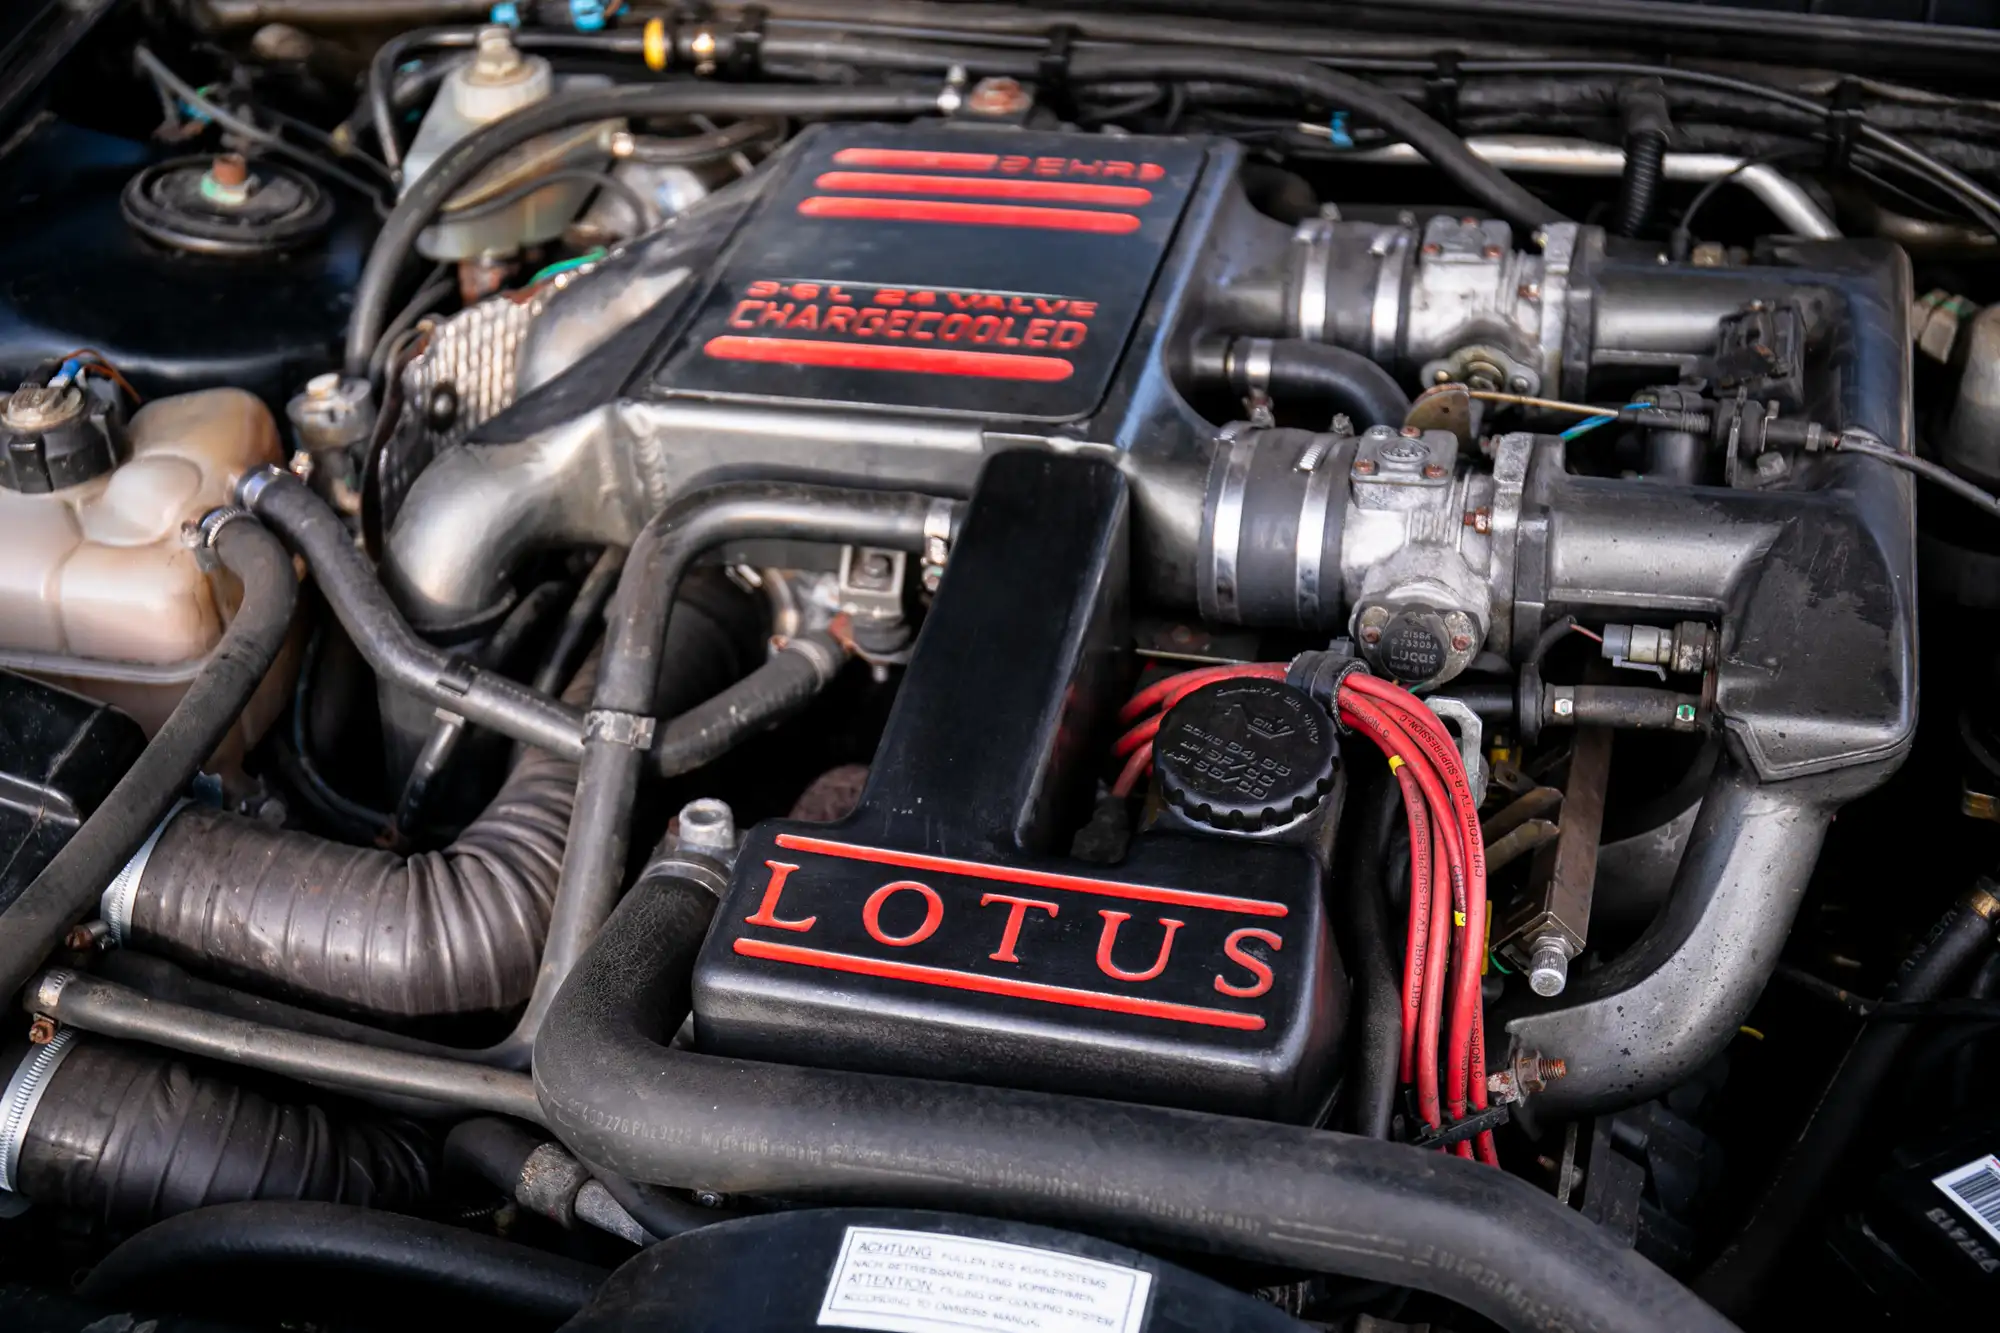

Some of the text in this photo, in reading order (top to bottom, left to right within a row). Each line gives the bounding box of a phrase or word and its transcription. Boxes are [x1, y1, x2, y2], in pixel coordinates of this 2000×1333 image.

[997, 155, 1135, 179] BEHR
[727, 300, 1088, 349] CHARGECOOLED
[873, 288, 936, 306] 24
[946, 291, 1098, 318] VALVE
[1467, 812, 1485, 878] CHT-CORE
[744, 859, 1284, 999] LOTUS
[1411, 941, 1427, 1009] CHT-CORE
